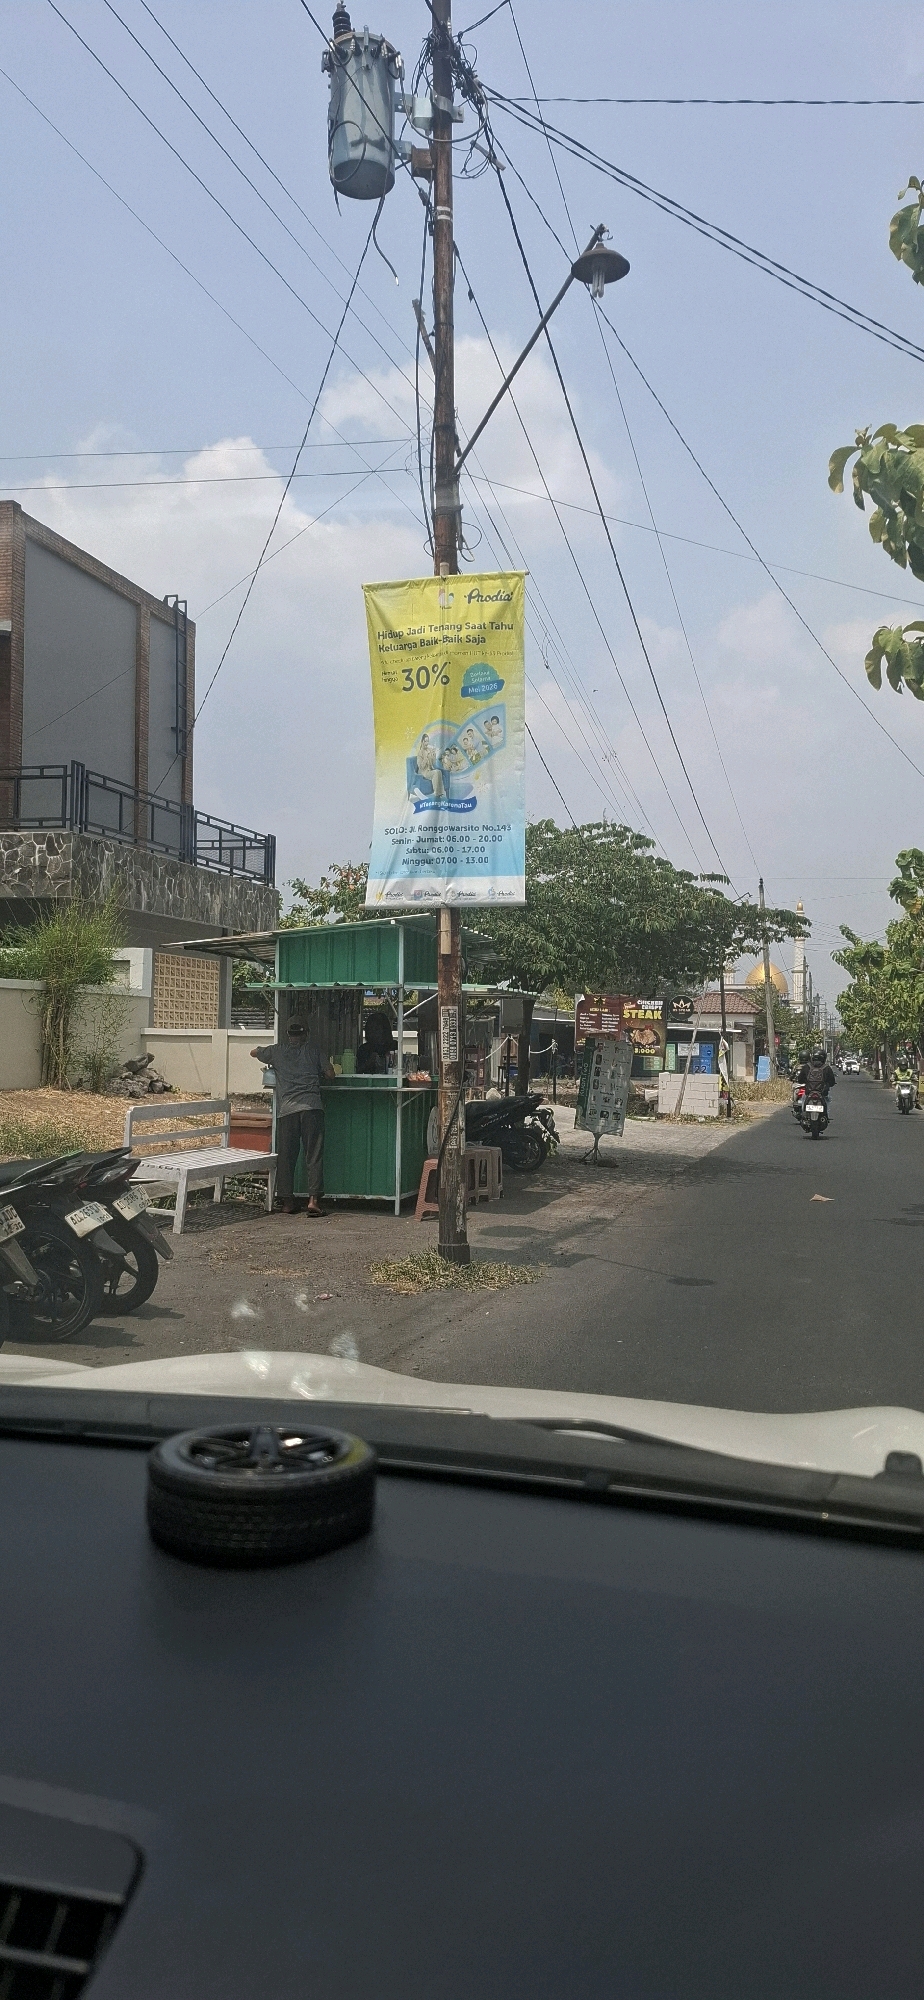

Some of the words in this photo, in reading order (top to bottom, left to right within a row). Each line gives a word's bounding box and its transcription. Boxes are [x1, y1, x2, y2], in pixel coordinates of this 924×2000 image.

[464, 588, 513, 604] Prodia
[378, 630, 404, 640] Hidup
[406, 626, 425, 637] Jadi
[429, 623, 462, 633] Tenang
[465, 622, 486, 630] Saat
[489, 621, 514, 630] Tahu
[378, 640, 417, 653] Keluarga
[420, 635, 462, 648] Baik-Baik
[465, 635, 486, 645] Saja
[468, 686, 481, 694] Mei
[482, 684, 498, 692] 2026
[385, 826, 407, 836] SOLO:
[418, 825, 480, 834] Ronggowarsito
[482, 824, 512, 832] No.143
[466, 856, 488, 864] 13.00
[623, 1009, 662, 1019] STEAK
